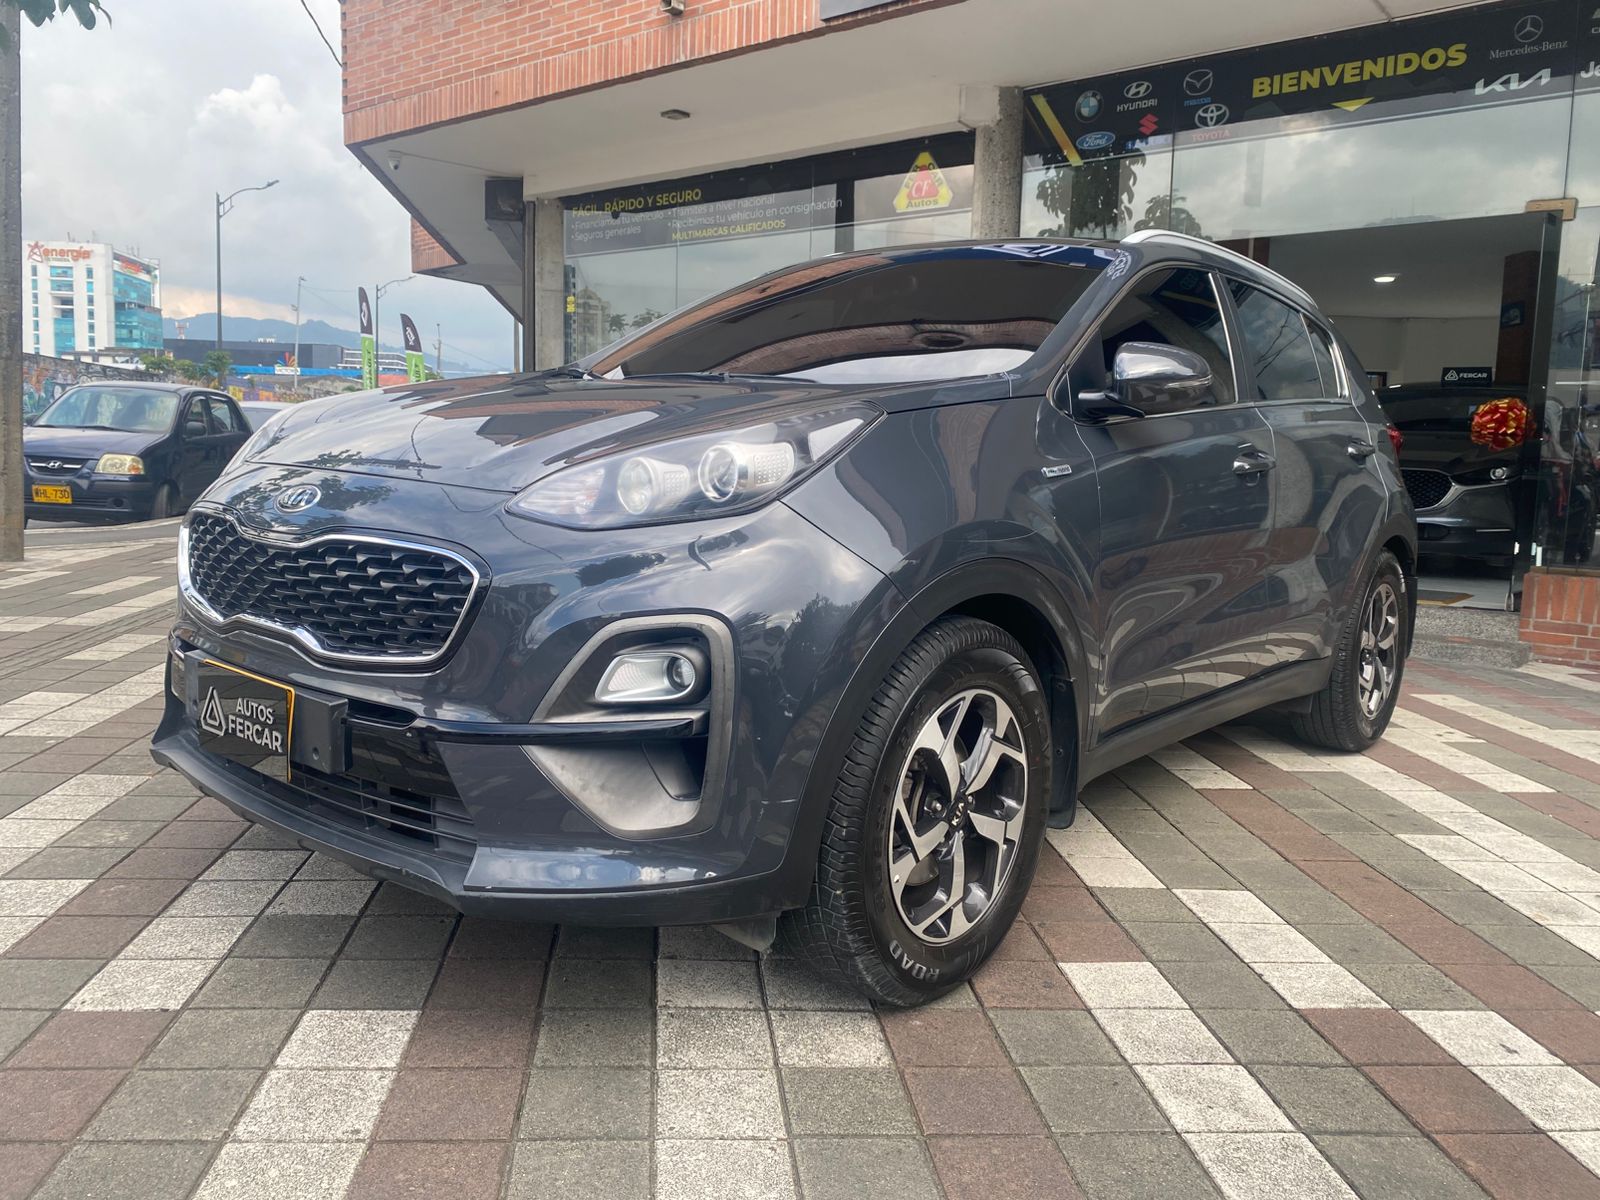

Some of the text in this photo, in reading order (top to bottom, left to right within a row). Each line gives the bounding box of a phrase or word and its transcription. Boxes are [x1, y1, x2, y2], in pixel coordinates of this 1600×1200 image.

[1489, 41, 1568, 60] Mercedes-Benz
[1252, 43, 1468, 98] BIENVENIDOS
[1474, 68, 1551, 95] KIA
[1116, 98, 1158, 112] HYUNDAI
[1082, 134, 1108, 148] Ford
[1191, 129, 1231, 142] TOYOTA
[604, 197, 645, 214] RÁPIDO
[647, 195, 655, 208] Y
[656, 188, 702, 206] SEGURO
[717, 213, 726, 222] tu
[766, 207, 778, 216] en
[779, 199, 843, 215] consignación
[906, 199, 938, 209] Autos
[574, 225, 642, 242] Seguros generales
[672, 219, 786, 241] MULTIMARCAS CALIFICADOS
[235, 697, 274, 725] AUTOS
[228, 714, 283, 753] FERCAR
[889, 939, 941, 984] ROAD
